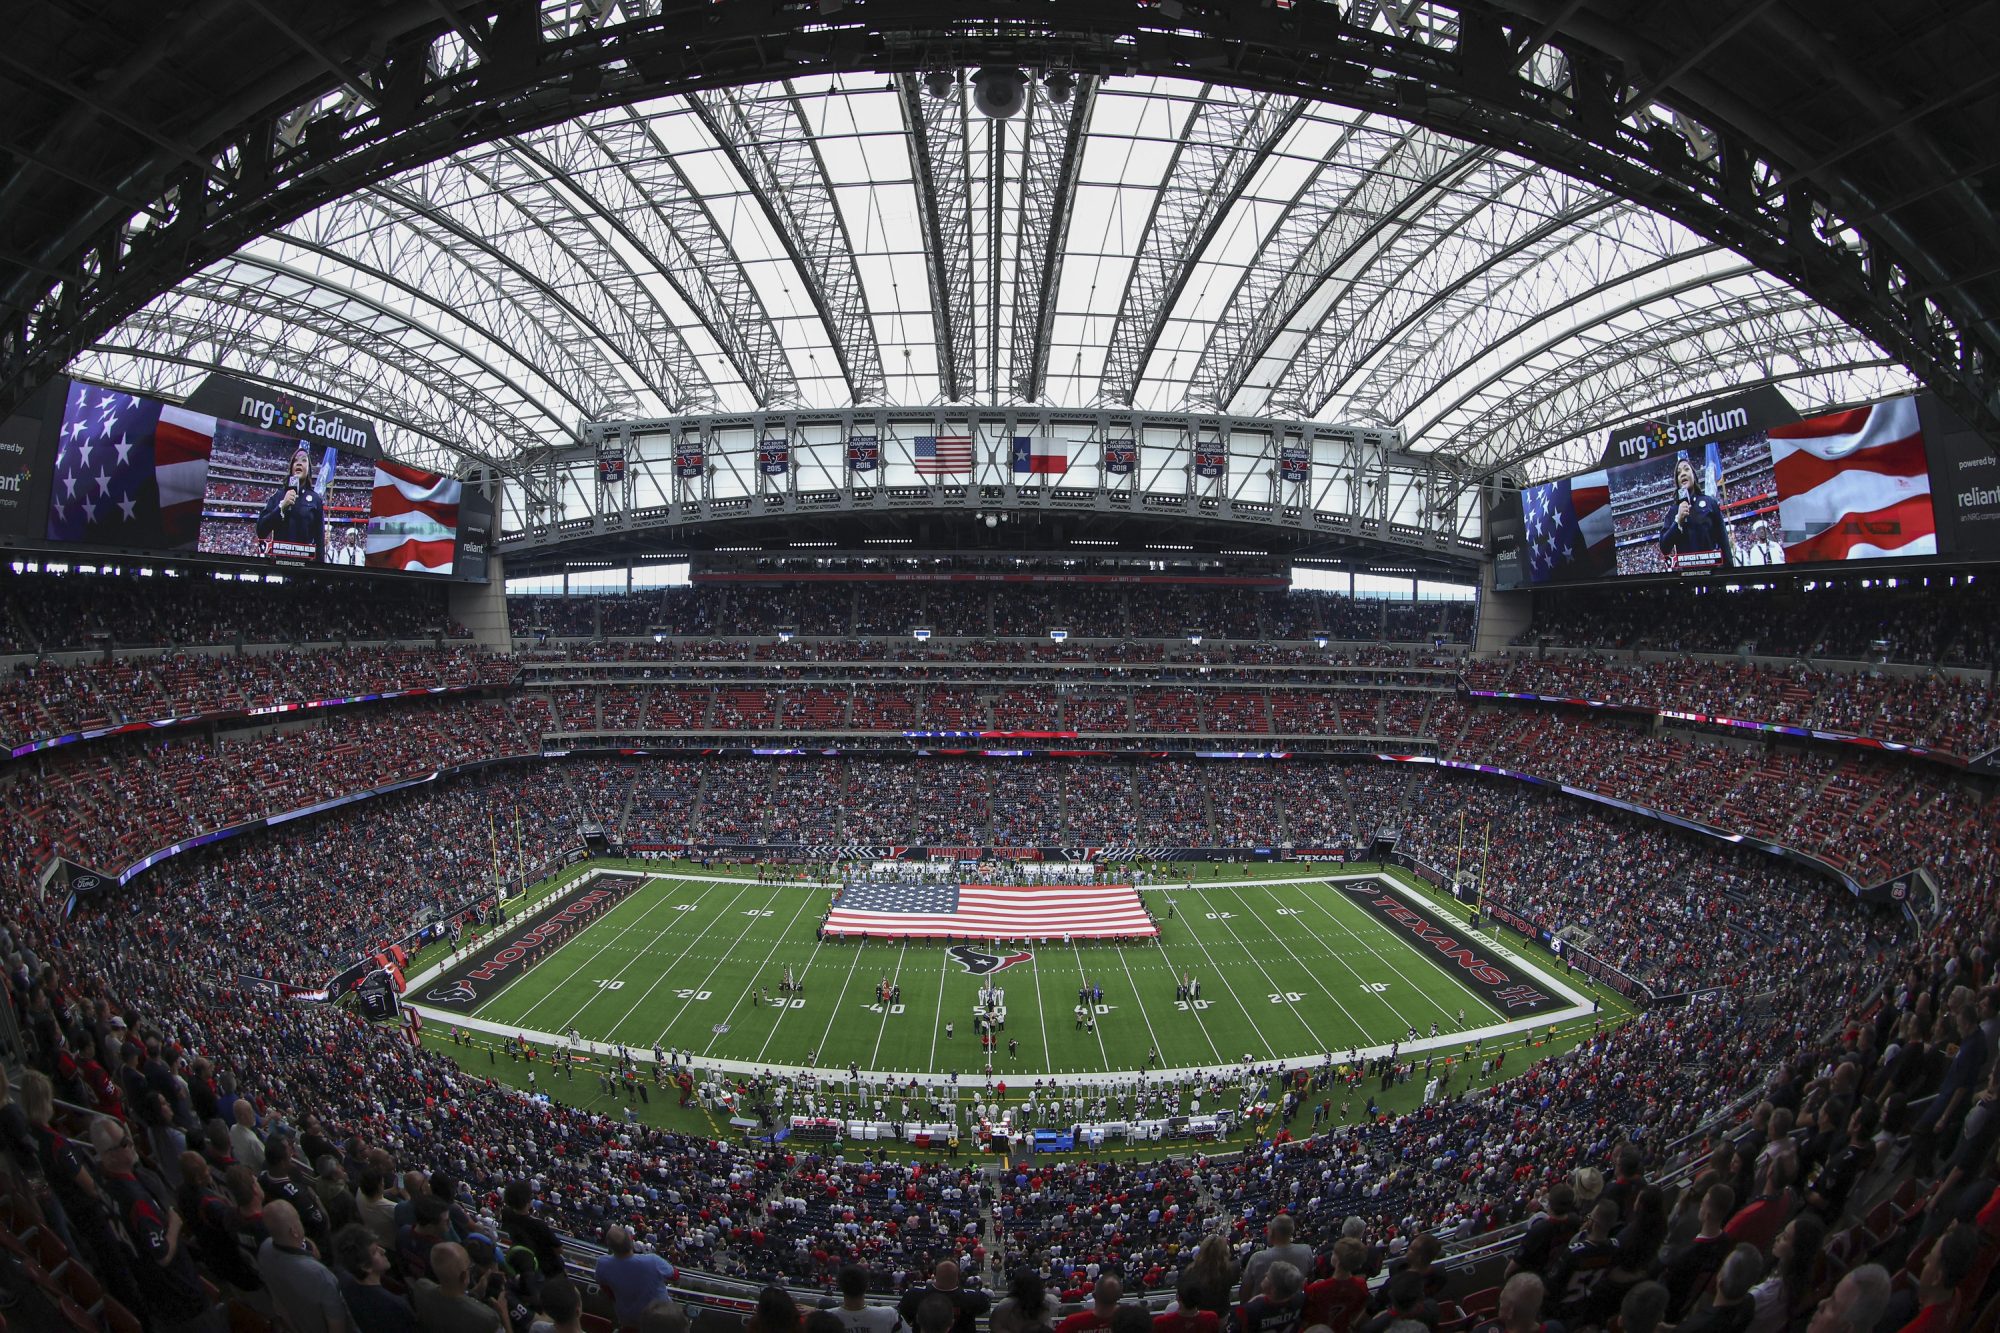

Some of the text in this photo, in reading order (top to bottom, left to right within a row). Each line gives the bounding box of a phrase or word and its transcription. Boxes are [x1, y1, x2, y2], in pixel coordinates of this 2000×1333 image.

[240, 396, 367, 448] nrg stadium
[1619, 407, 1748, 460] nrg stadium
[0, 443, 24, 454] ered by
[1959, 456, 1996, 470] powered by
[1958, 486, 2000, 508] reliant
[464, 542, 483, 554] reliant
[1497, 550, 1517, 561] reliant
[927, 848, 982, 860] HOUSTON
[468, 890, 612, 980] HOUSTON
[1428, 905, 1462, 924] SALUTE
[1473, 932, 1516, 958] SERVICE
[1372, 895, 1510, 984] TEXANS
[598, 980, 625, 989] 10
[1360, 983, 1386, 993] 10
[676, 990, 712, 1000] 20
[1268, 992, 1301, 1003] 20
[771, 998, 806, 1008] 30
[870, 1004, 905, 1014] 40
[1174, 1000, 1208, 1010] 30
[973, 1006, 1006, 1016] 50
[1074, 1005, 1109, 1014] 40
[284, 1182, 298, 1196] 12
[510, 1303, 528, 1320] 98
[1262, 1312, 1293, 1328] STINGLEY
